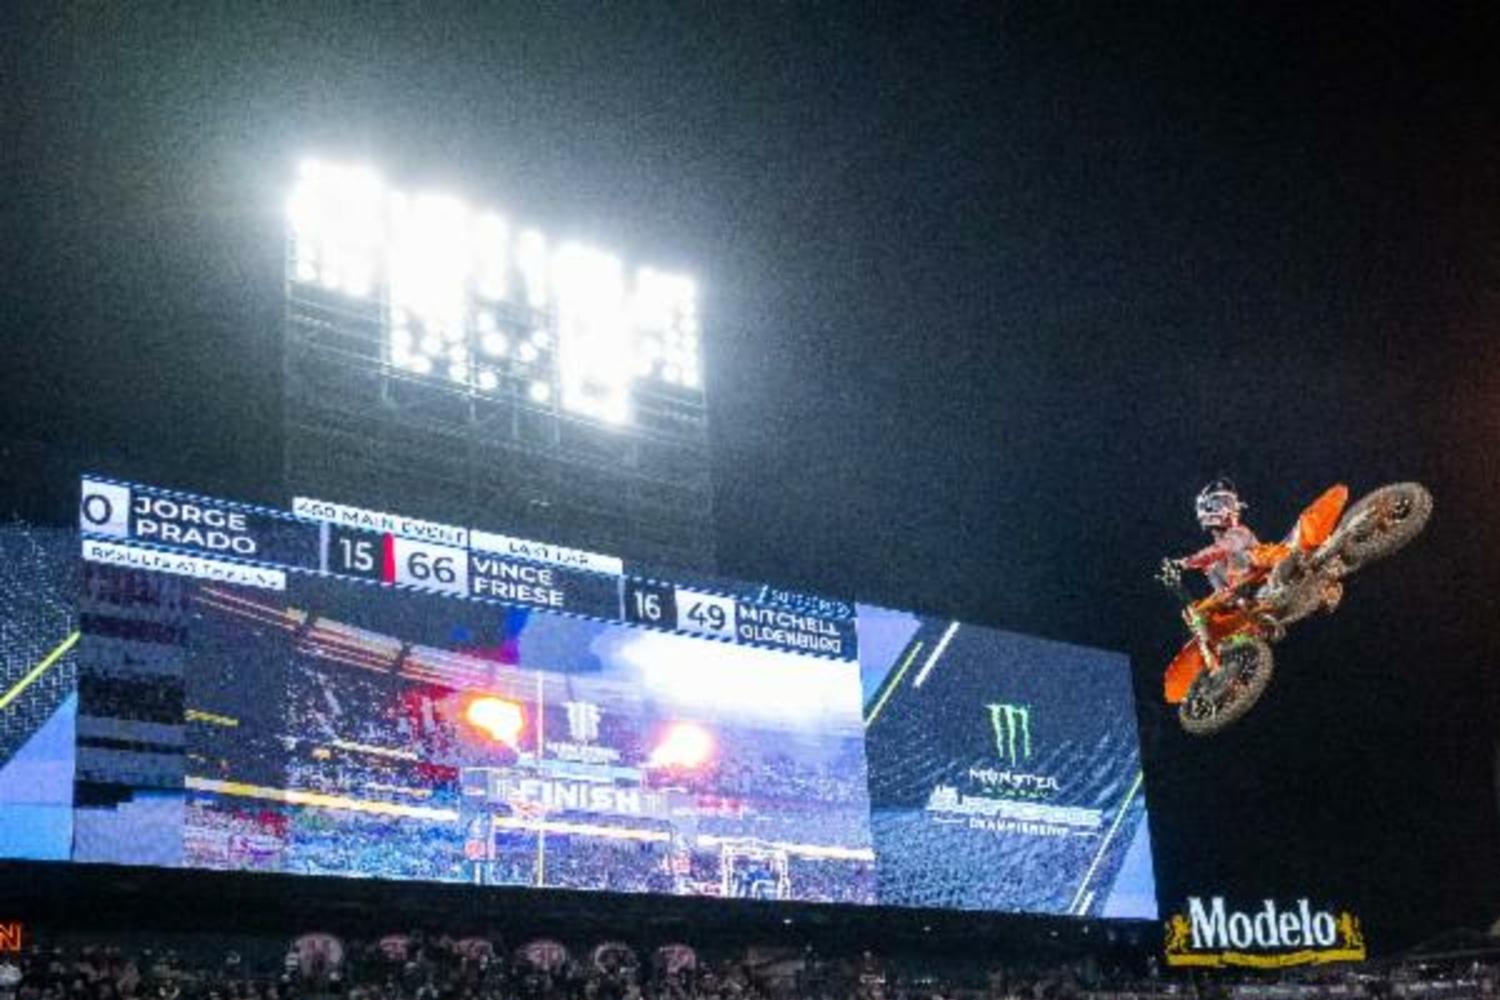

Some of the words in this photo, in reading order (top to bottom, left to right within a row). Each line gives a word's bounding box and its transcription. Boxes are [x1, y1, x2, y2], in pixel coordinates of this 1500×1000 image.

[134, 496, 248, 532] JORGE
[135, 519, 257, 555] PRADO
[339, 538, 374, 571] 15
[407, 551, 457, 584] 66
[472, 556, 554, 584] VINCE
[473, 576, 565, 607] FRIESE
[634, 590, 661, 620] 16
[687, 601, 726, 631] 49
[739, 604, 841, 636] MITCHELL
[1187, 896, 1337, 949] Modelo
